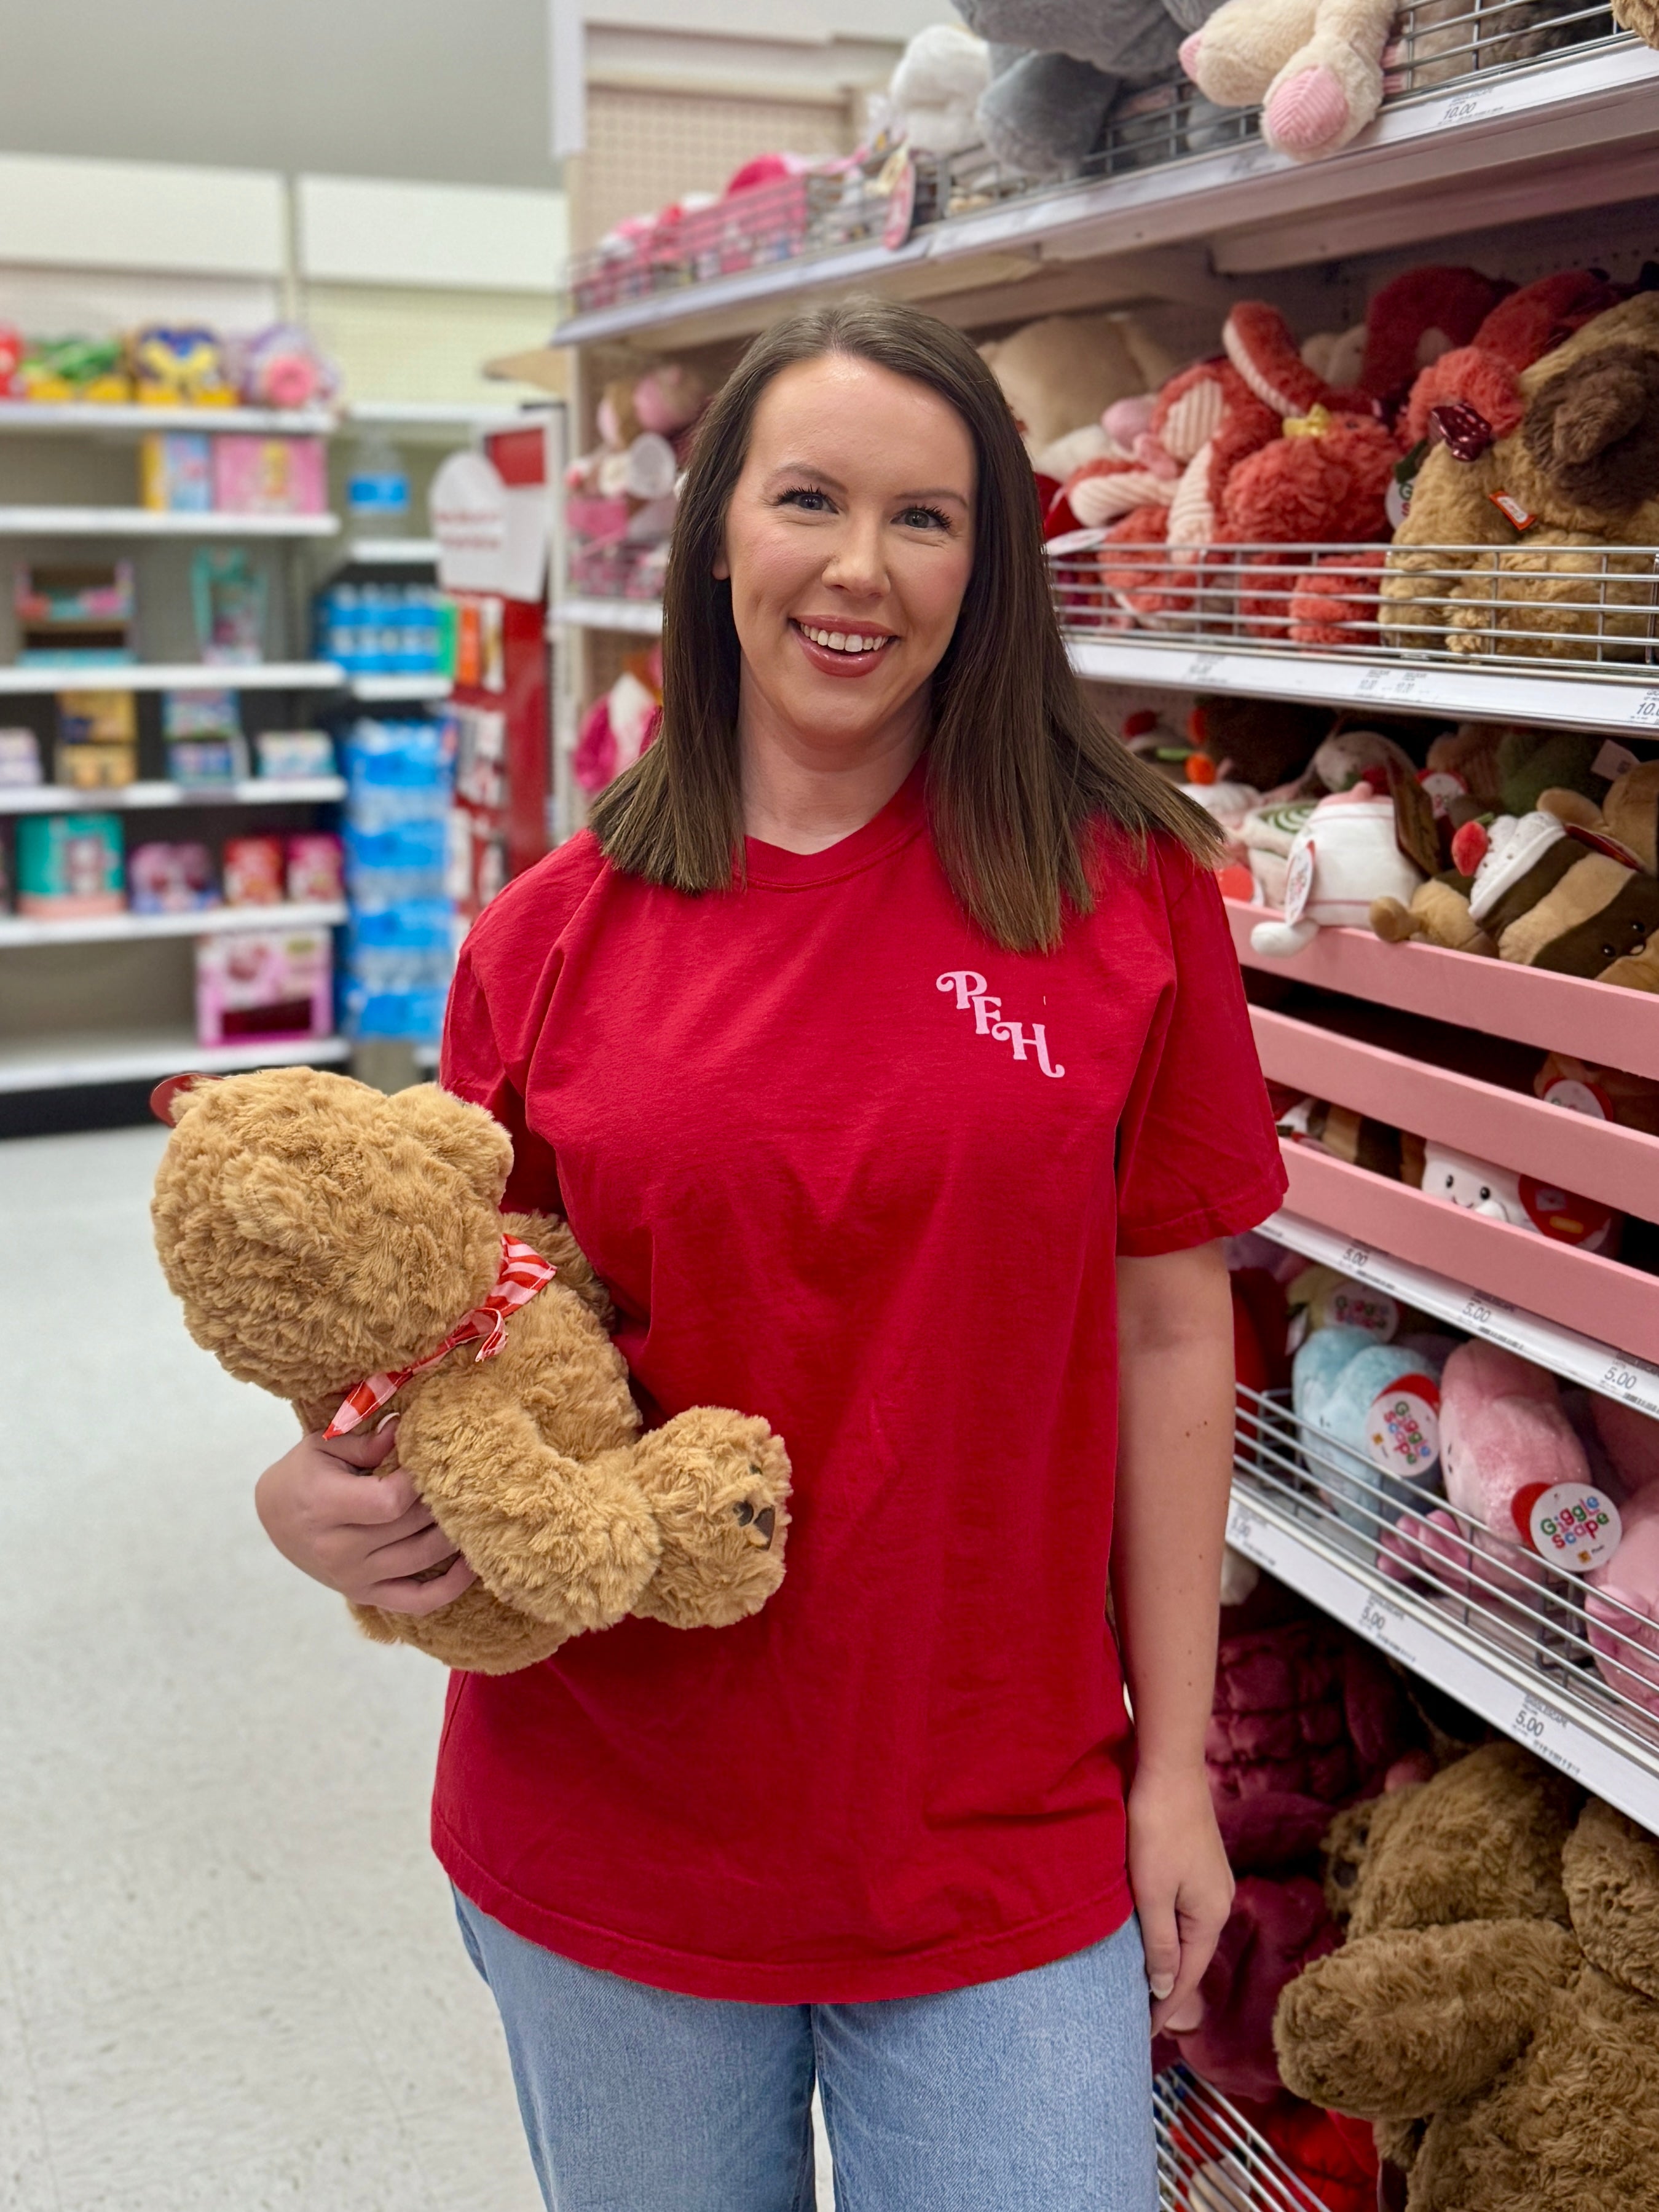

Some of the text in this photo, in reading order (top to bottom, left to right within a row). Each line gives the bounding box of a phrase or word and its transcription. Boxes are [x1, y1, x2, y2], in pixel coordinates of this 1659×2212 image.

[1443, 101, 1477, 120] 10.00
[1637, 702, 1659, 716] 10.
[1463, 1302, 1491, 1323] 5.00
[1604, 1367, 1637, 1389] 5.00
[1540, 1496, 1599, 1536] Giggle
[1516, 1709, 1544, 1737] 5.00
